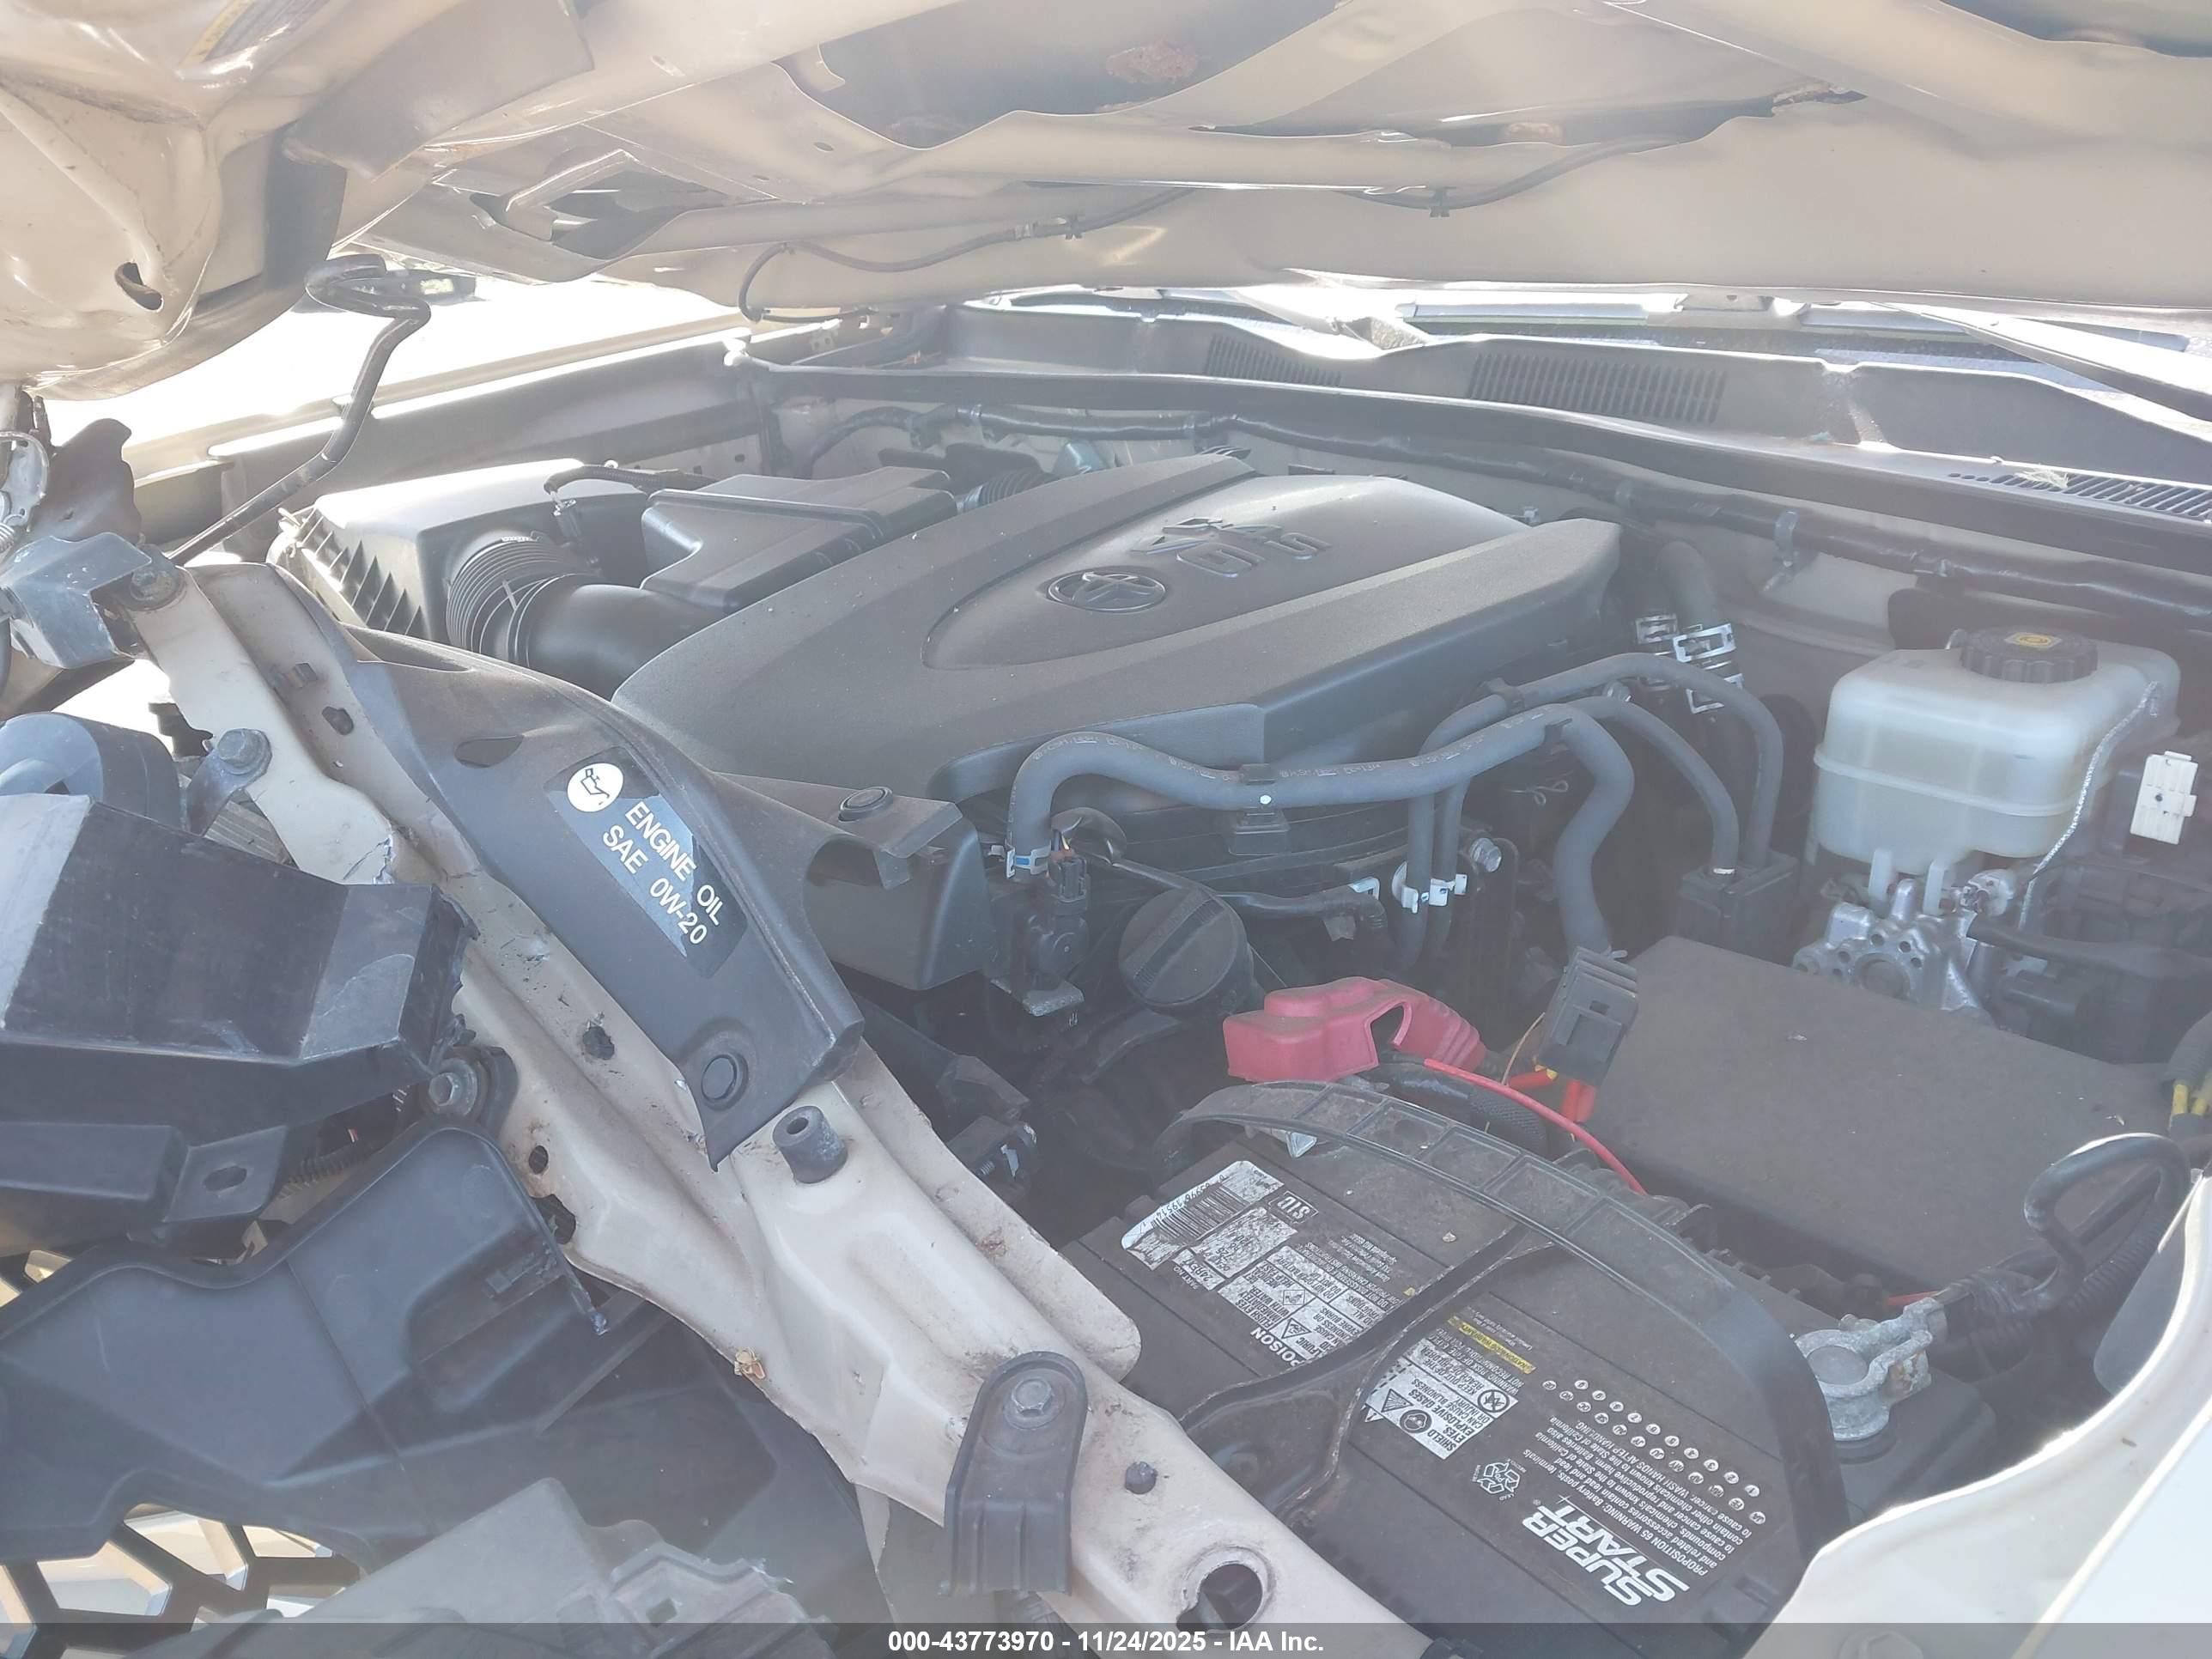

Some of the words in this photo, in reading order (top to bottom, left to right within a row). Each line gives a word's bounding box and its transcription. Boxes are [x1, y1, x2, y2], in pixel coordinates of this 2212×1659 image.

[625, 801, 697, 882] ENGINE
[697, 884, 723, 926] OIL
[603, 825, 649, 874] SAE
[650, 878, 708, 945] 0W-20
[1213, 1245, 1234, 1261] 725
[1180, 1273, 1198, 1290] PART
[1241, 1271, 1259, 1285] GET
[1249, 1266, 1281, 1289] MEDICAL
[1274, 1273, 1295, 1288] HELP
[1296, 1271, 1315, 1285] OPEN
[1310, 1281, 1327, 1293] NOT
[1316, 1275, 1333, 1288] NOT
[1246, 1284, 1273, 1304] WATER.
[1322, 1289, 1334, 1299] DO
[1328, 1284, 1342, 1294] DO
[1233, 1297, 1255, 1313] EYES
[1236, 1289, 1284, 1322] IMMEDIATELY
[1268, 1300, 1291, 1316] WITH
[1248, 1310, 1274, 1328] FLUSH
[1312, 1323, 1335, 1341] CAUSE
[1249, 1326, 1304, 1367] POISON
[1421, 1358, 1438, 1370] THE
[1461, 1355, 1474, 1365] OF
[1434, 1366, 1448, 1376] OF
[1443, 1371, 1461, 1385] OUT
[1449, 1365, 1464, 1376] OF
[1410, 1377, 1449, 1405] BLINDNESS
[1456, 1381, 1477, 1396] KEEP
[1459, 1372, 1485, 1391] REACH
[1407, 1388, 1436, 1409] GASES
[1451, 1395, 1480, 1417] INJURY.
[1444, 1401, 1470, 1419] CAUSE
[1476, 1413, 1491, 1424] OR
[1430, 1404, 1476, 1437] EXPLOSIVE
[1466, 1416, 1484, 1430] CAN
[1547, 1414, 1584, 1442] California
[1425, 1428, 1457, 1451] SHIELD
[1438, 1424, 1467, 1443] EYES.
[1544, 1425, 1565, 1441] also
[1571, 1419, 1616, 1449] HANDLING.
[1579, 1437, 1591, 1446] of
[1532, 1431, 1571, 1457] California
[1559, 1436, 1595, 1461] Batteries
[1587, 1442, 1611, 1459] State
[1520, 1448, 1558, 1474] terminals
[1553, 1456, 1573, 1472] lead
[1565, 1452, 1578, 1462] of
[1606, 1454, 1623, 1467] the
[1611, 1443, 1640, 1466] AFTER
[1568, 1467, 1587, 1481] and
[1572, 1457, 1597, 1474] State
[1589, 1455, 1616, 1475] harm.
[1619, 1462, 1632, 1473] to
[1634, 1460, 1667, 1483] HANDS
[1492, 1473, 1505, 1483] Pb
[1553, 1468, 1580, 1488] posts,
[1583, 1476, 1603, 1492] lead
[1592, 1470, 1609, 1483] the
[1604, 1478, 1617, 1488] to
[1626, 1468, 1656, 1489] known
[1573, 1483, 1606, 1506] Battery
[1612, 1470, 1662, 1504] reproductive
[1612, 1483, 1641, 1504] known
[1662, 1477, 1692, 1498] WASH
[1598, 1487, 1631, 1510] contain
[1650, 1482, 1693, 1513] chemicals
[1656, 1499, 1676, 1515] and
[1687, 1492, 1720, 1516] cancer.
[1600, 1502, 1643, 1534] WARNING:
[1626, 1505, 1674, 1540] accessories
[1636, 1499, 1680, 1530] chemicals
[1672, 1510, 1702, 1531] cancer
[1689, 1508, 1715, 1527] other
[1716, 1511, 1743, 1532] cause
[1638, 1528, 1655, 1540] 65
[1698, 1527, 1726, 1547] cause
[1710, 1522, 1745, 1547] contain
[1738, 1527, 1753, 1539] to
[1536, 1504, 1690, 1600] START
[1669, 1535, 1702, 1559] related
[1674, 1524, 1729, 1562] compounds,
[1722, 1543, 1736, 1554] to
[1520, 1510, 1653, 1607] SUPER
[1649, 1535, 1709, 1577] PROPOSITION
[1697, 1553, 1718, 1570] and
